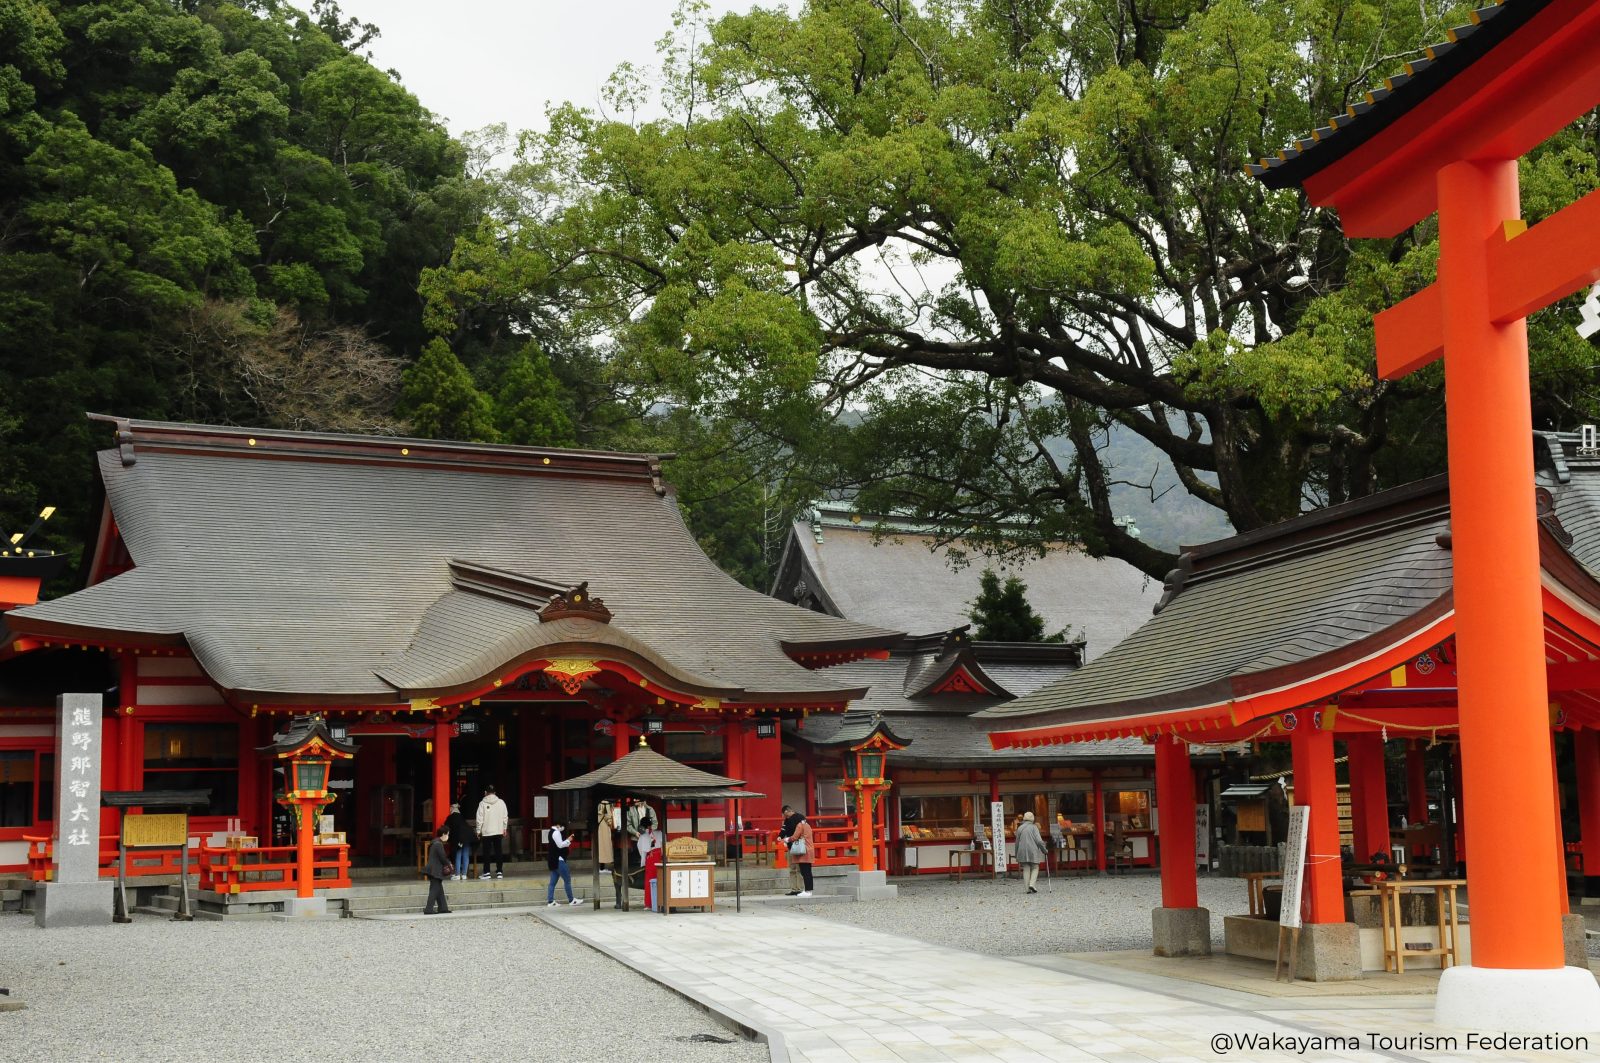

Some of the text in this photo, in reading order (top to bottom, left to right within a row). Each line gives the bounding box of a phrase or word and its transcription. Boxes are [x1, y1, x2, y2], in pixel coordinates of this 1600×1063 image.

[67, 707, 93, 846] 熊野那智大社
